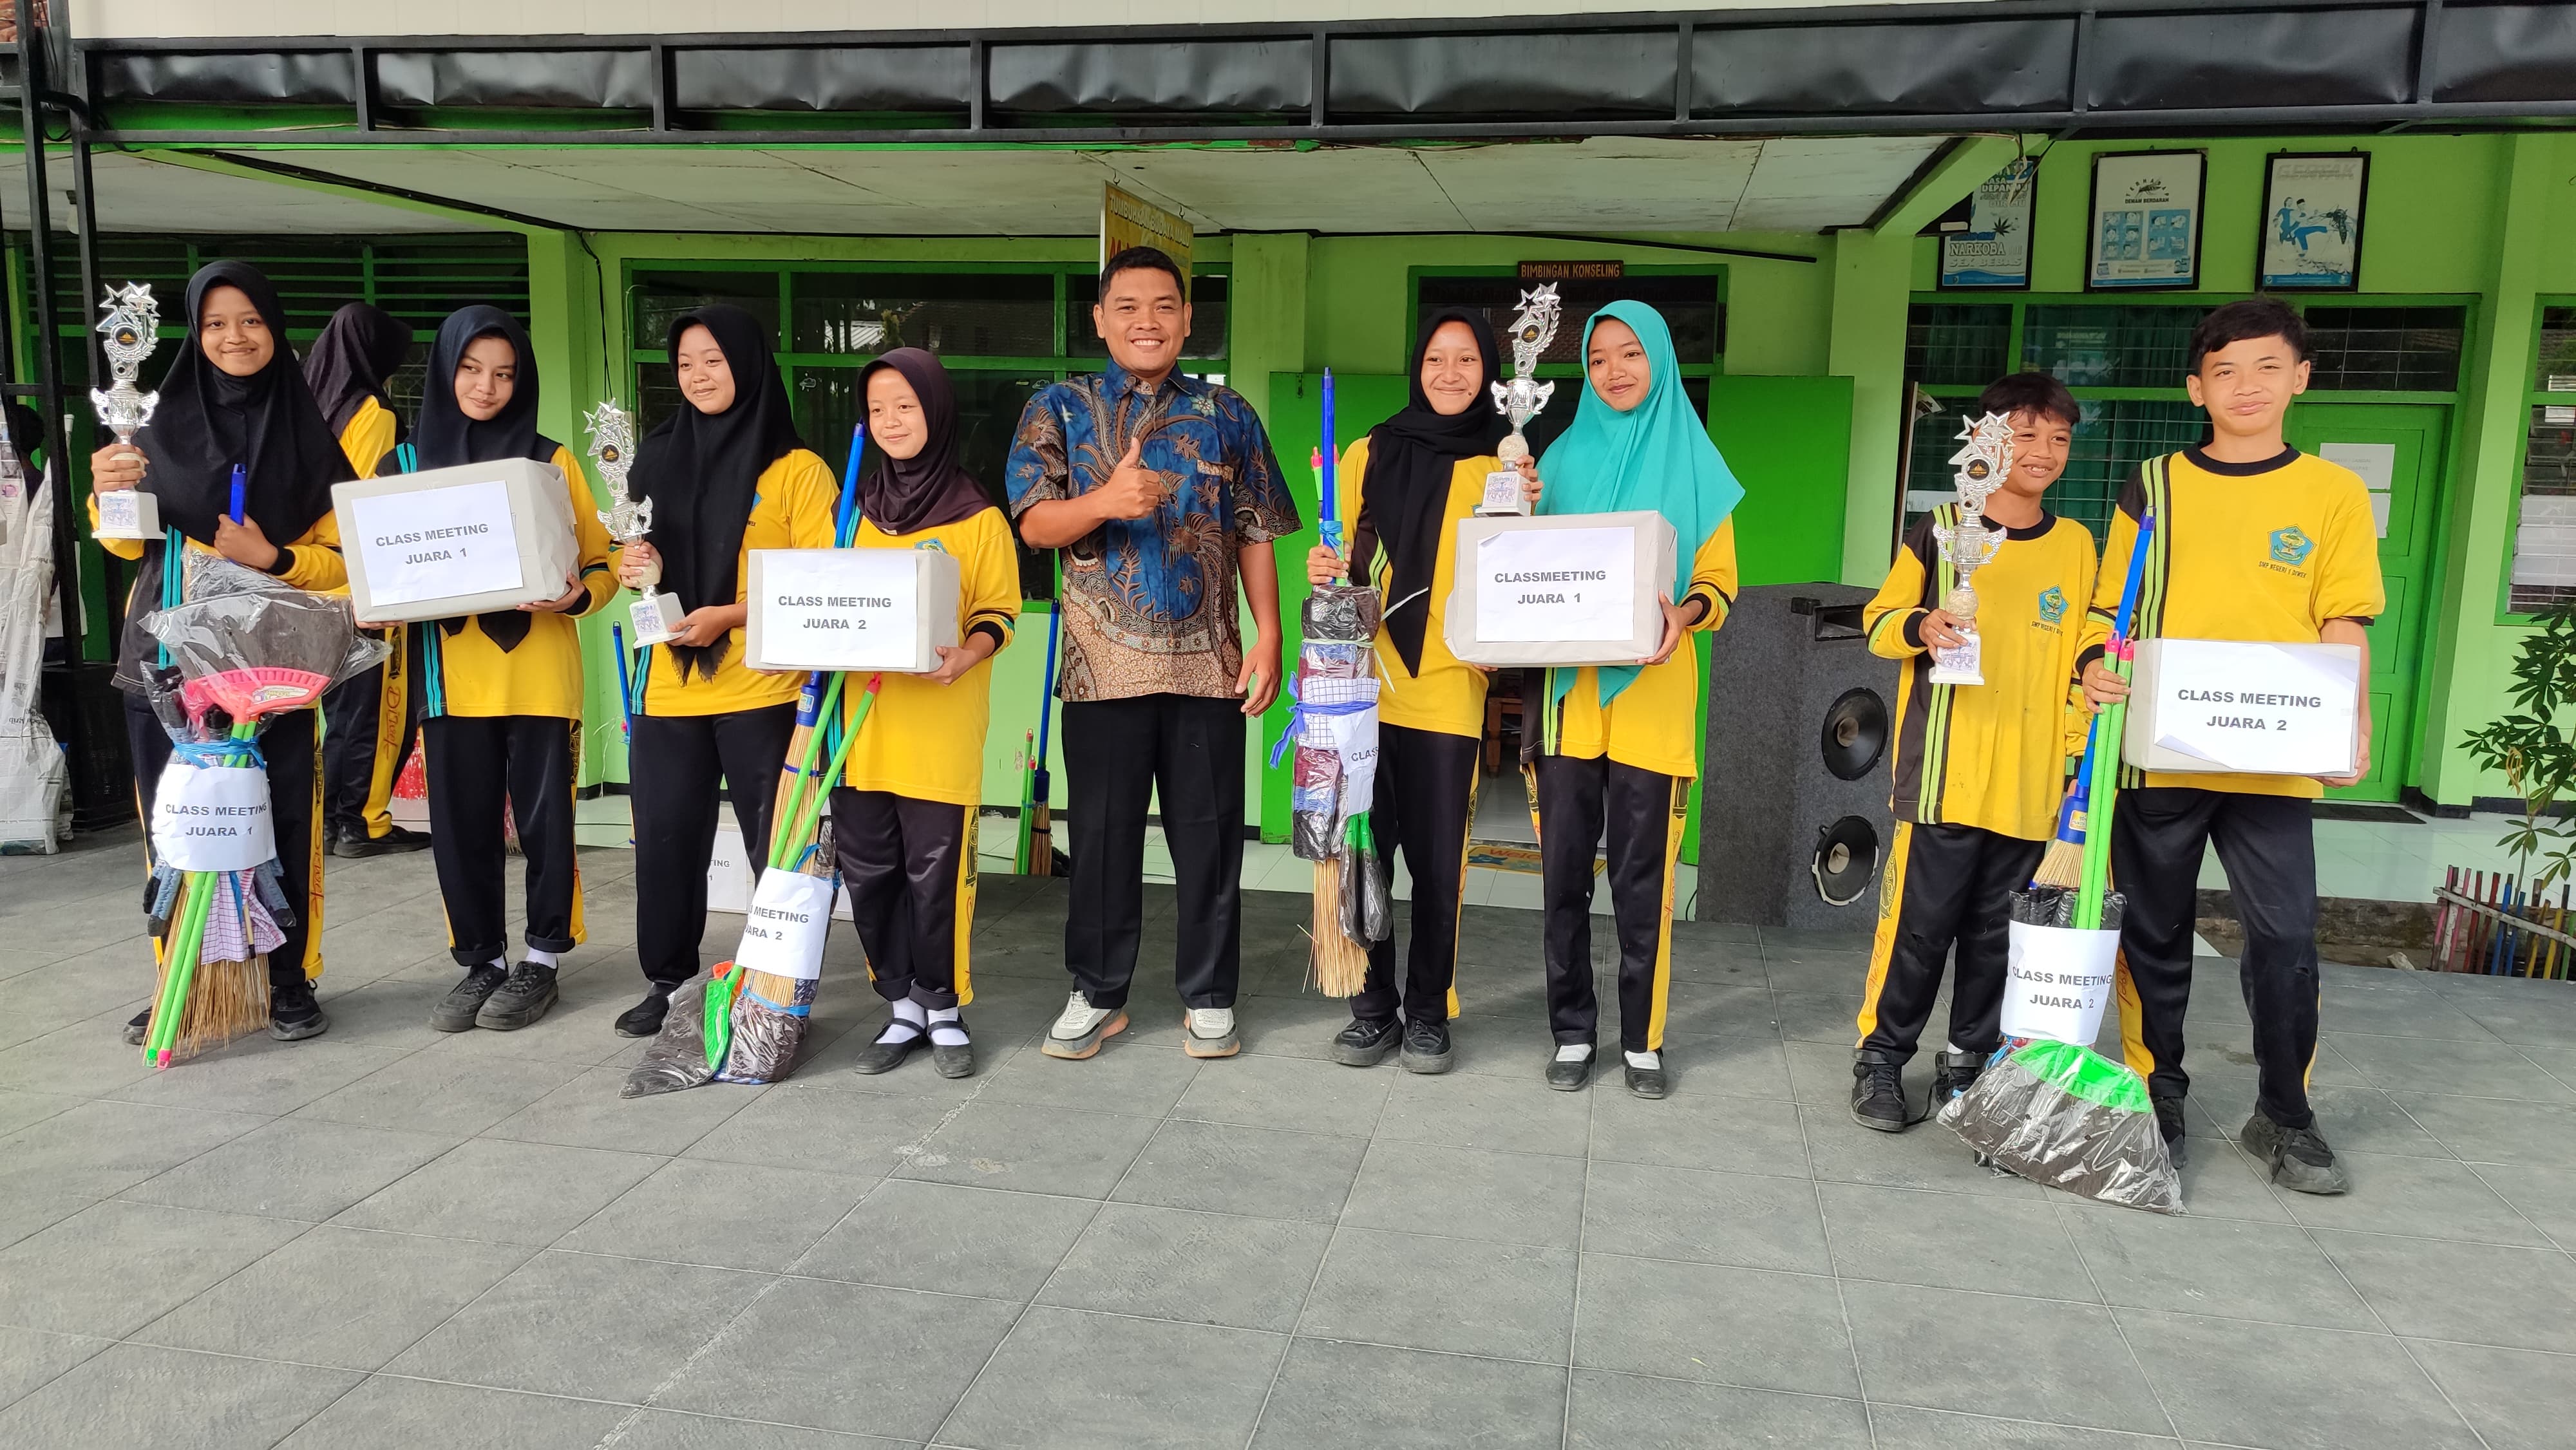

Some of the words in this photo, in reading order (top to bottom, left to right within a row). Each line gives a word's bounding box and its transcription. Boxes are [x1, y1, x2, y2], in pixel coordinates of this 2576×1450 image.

[1949, 243, 2005, 256] NARKOBA
[1521, 265, 1569, 278] BIMBINGAN
[1572, 264, 1620, 278] KONSELING
[375, 532, 421, 547] CLASS
[424, 523, 488, 540] MEETING
[405, 550, 452, 565] JUARA
[460, 547, 467, 557] 1
[1494, 570, 1606, 583] CLASSMEETING
[778, 596, 822, 607] CLASS
[828, 596, 891, 608] MEETING
[1517, 594, 1565, 605] JUARA
[1574, 593, 1580, 603] 1
[803, 619, 849, 629] JUARA
[858, 619, 866, 630] 2
[2178, 689, 2234, 702] CLASS
[2240, 693, 2321, 708] MEETING
[2206, 716, 2266, 730] JUARA
[2277, 720, 2287, 731] 2
[166, 804, 210, 816] CLASS
[215, 802, 267, 816] MEETING
[185, 827, 238, 836] JUARA
[247, 826, 252, 835] 1
[1490, 849, 1541, 860] Welc
[753, 907, 809, 923] MEETING
[775, 931, 782, 941] 2
[2012, 966, 2054, 983] CLASS
[2059, 974, 2113, 986] MEETING
[2030, 994, 2083, 1009] JUARA
[2088, 998, 2094, 1009] 2
